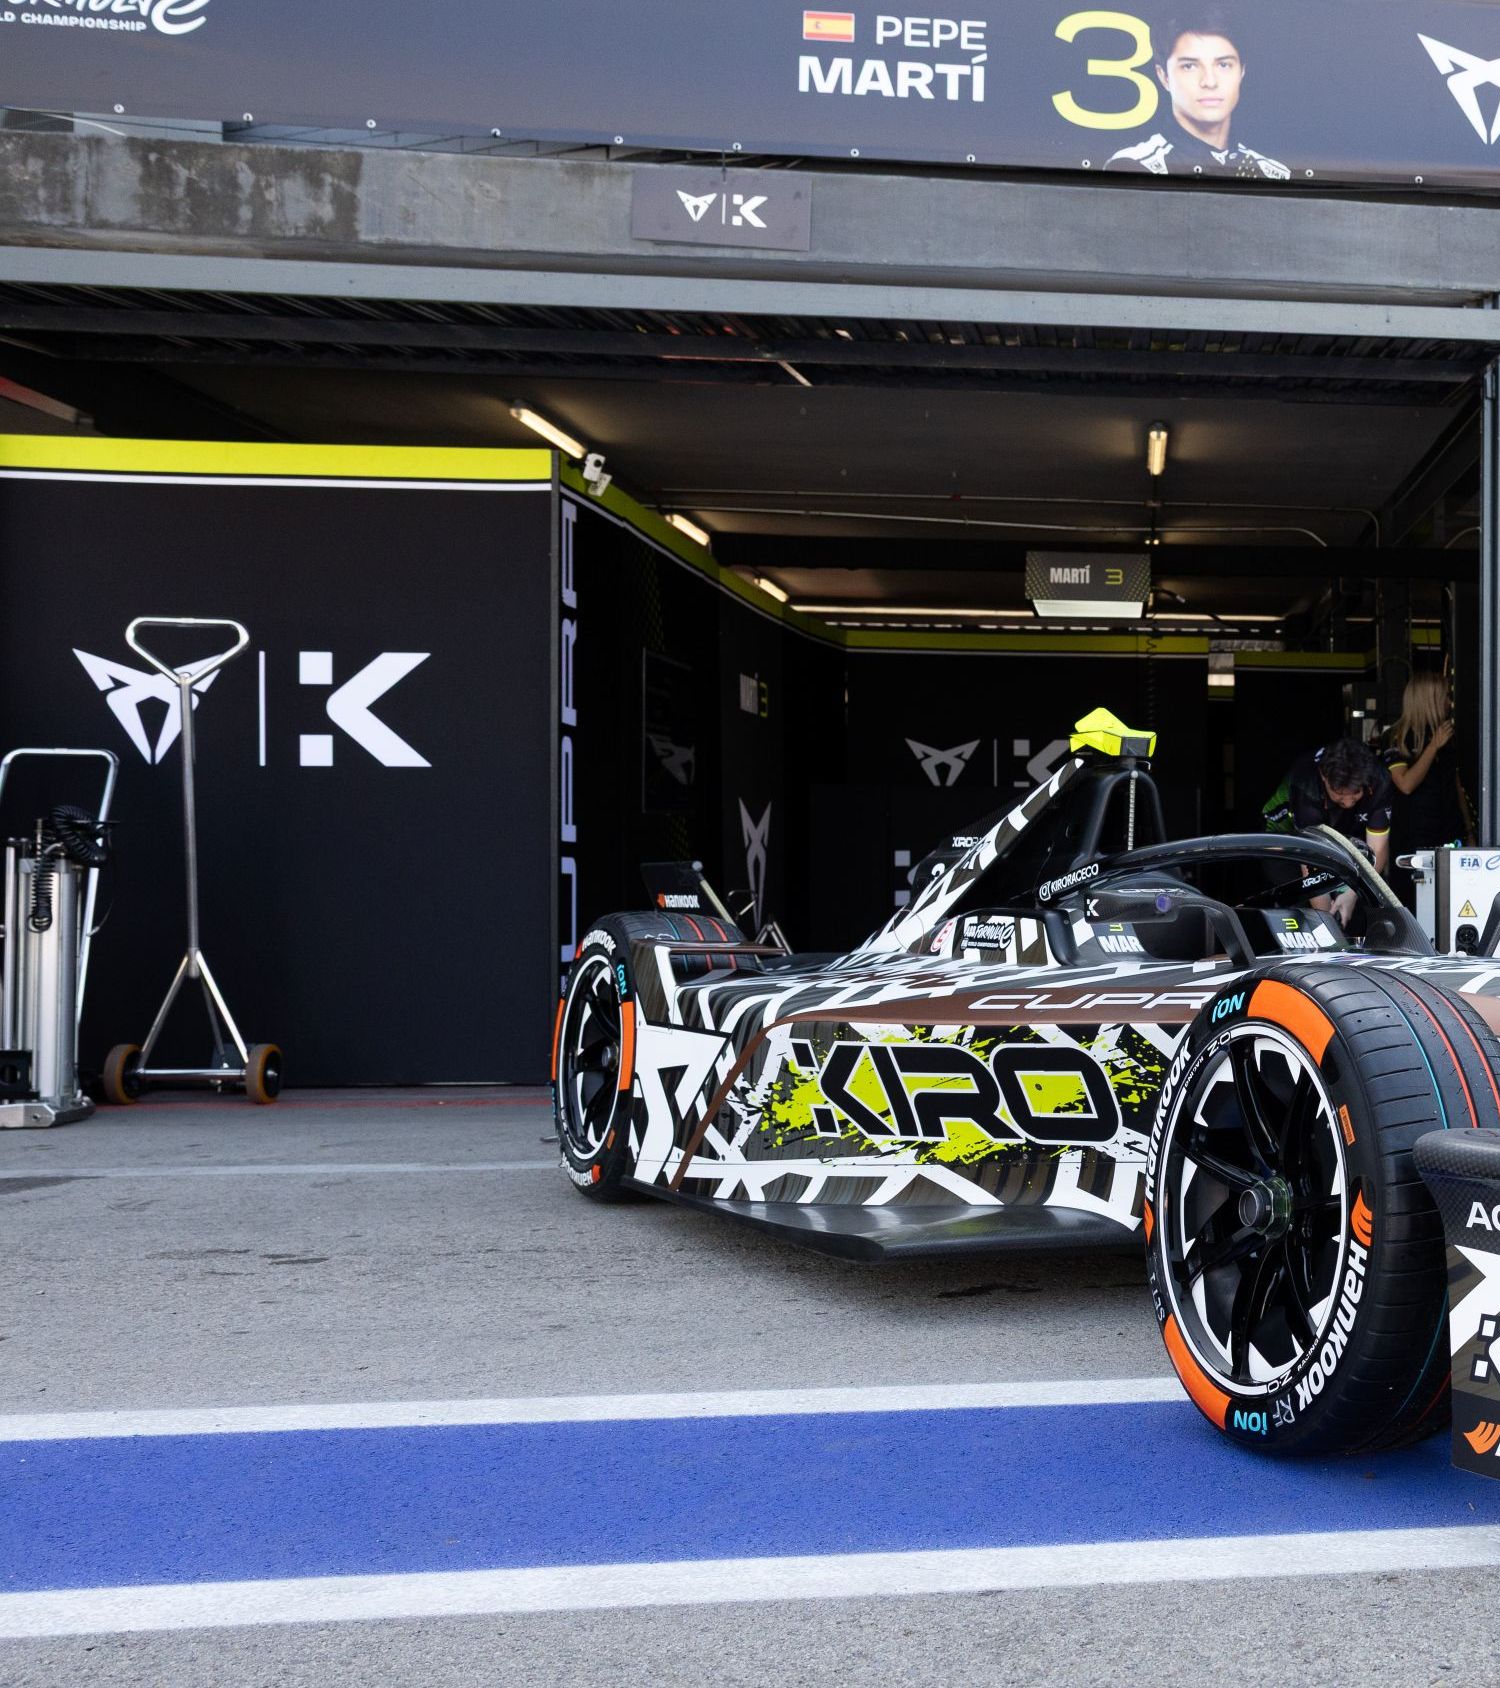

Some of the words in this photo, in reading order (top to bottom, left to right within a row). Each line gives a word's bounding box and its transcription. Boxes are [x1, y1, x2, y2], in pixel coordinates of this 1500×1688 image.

[21, 13, 147, 31] CHAMPIONSHIP
[876, 16, 987, 51] PEPE
[799, 53, 988, 101] MARTÍ
[1051, 10, 1159, 130] 3
[1050, 565, 1090, 585] MARTÍ
[1105, 569, 1124, 585] 3
[1050, 863, 1099, 892] KIRORACECO
[1282, 918, 1298, 929] 3
[1098, 935, 1145, 952] MAR
[1277, 932, 1319, 948] MAR
[968, 992, 1218, 1009] CUPR
[1185, 1056, 1204, 1088] RACING
[788, 1037, 1123, 1143] KIRO
[1298, 1338, 1319, 1371] RACING
